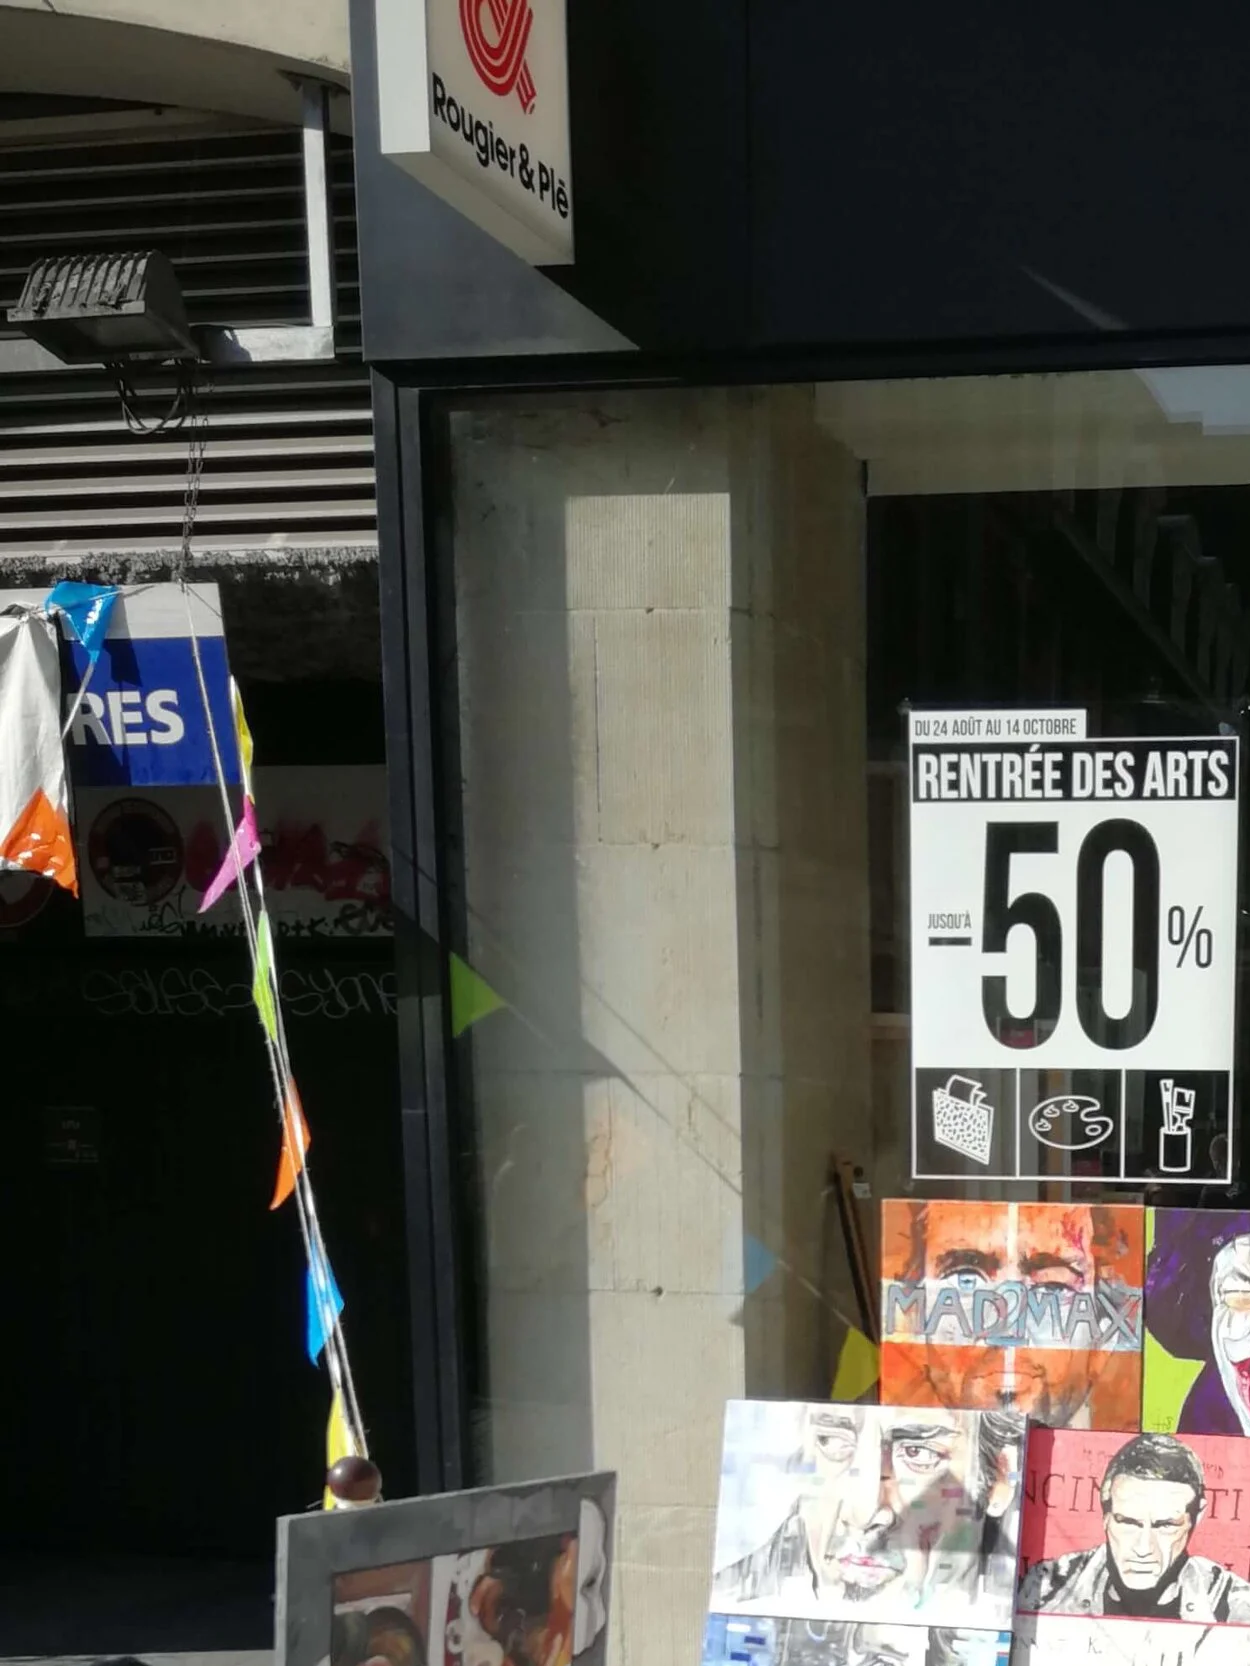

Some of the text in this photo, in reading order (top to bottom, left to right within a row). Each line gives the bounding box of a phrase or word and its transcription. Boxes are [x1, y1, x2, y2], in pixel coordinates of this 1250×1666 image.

[66, 689, 185, 746] RES
[915, 715, 1077, 737] DU 24 AOÛT AU 14 OCTOBRE
[918, 744, 1230, 800] RENTRÉE DES ARTS
[927, 909, 973, 930] JUSQU'À
